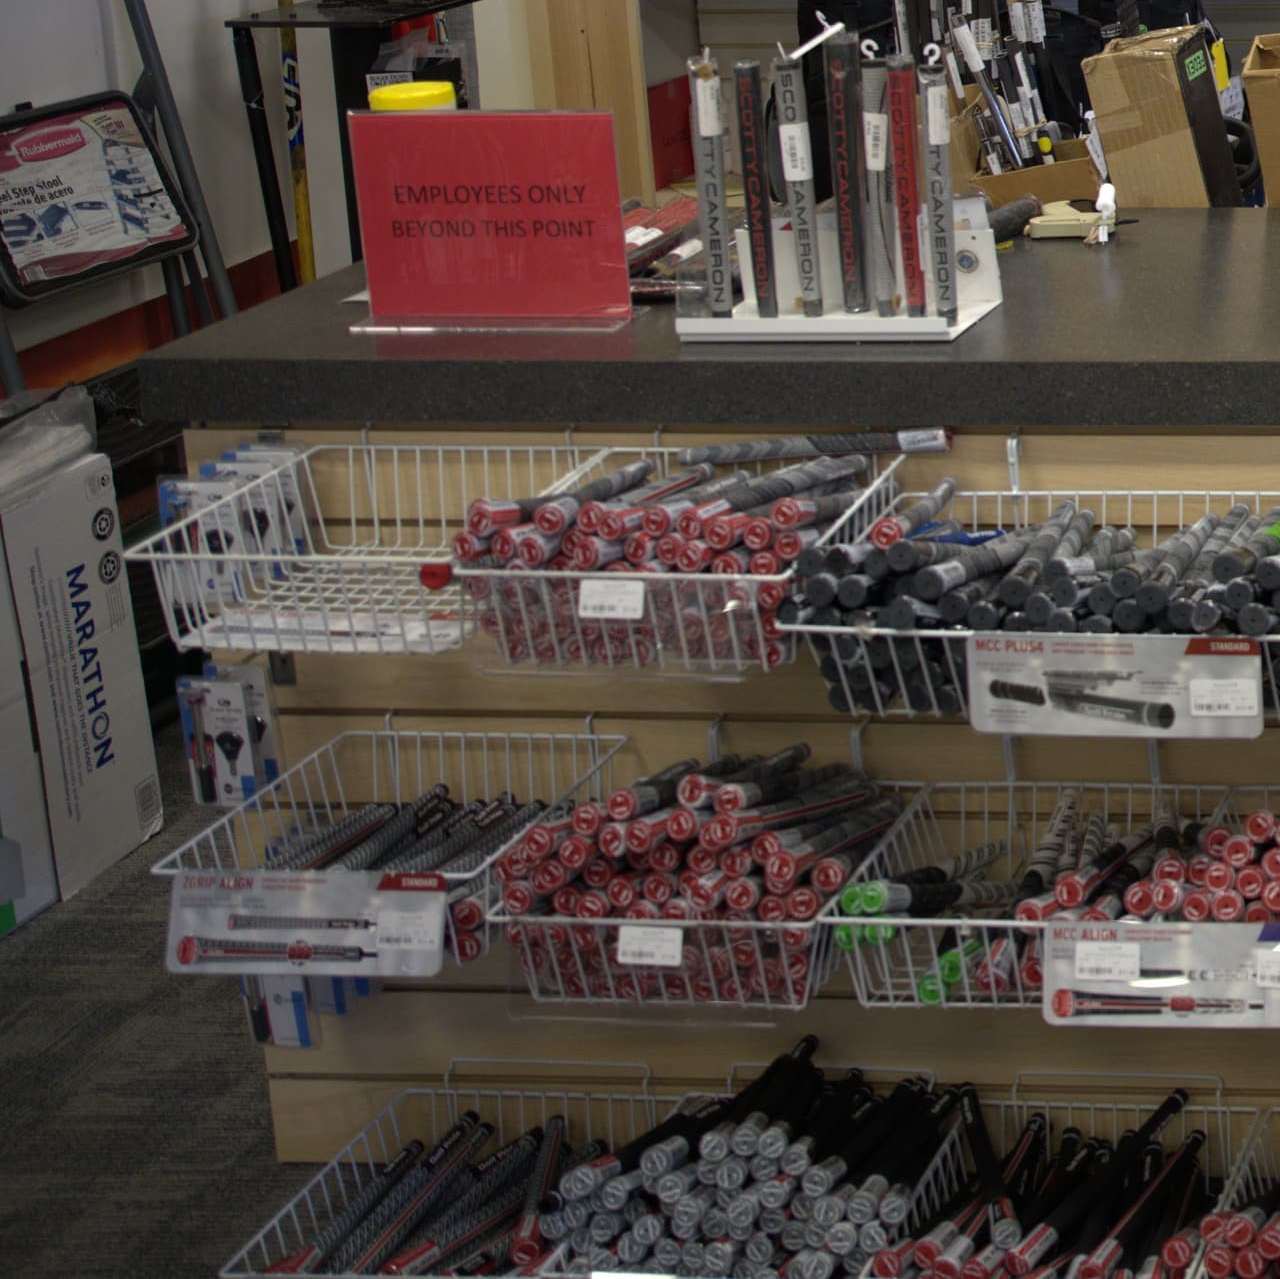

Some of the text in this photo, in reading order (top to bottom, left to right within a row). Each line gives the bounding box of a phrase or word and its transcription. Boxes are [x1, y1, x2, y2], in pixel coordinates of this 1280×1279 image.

[20, 133, 82, 157] Rubbermaid
[12, 186, 36, 200] Step
[49, 186, 74, 201] acero
[393, 184, 587, 204] EMPLOYEES ONLY
[391, 219, 596, 238] BEYOND THIS POINT
[975, 640, 1001, 651] MCC
[1005, 640, 1044, 653] PLUS4
[1209, 641, 1250, 652] STANDARD
[66, 563, 115, 770] MARATHON
[219, 876, 254, 890] ALIGN
[400, 878, 439, 889] STANDARD
[1053, 929, 1077, 941] MCC
[1081, 928, 1118, 940] ALIGN
